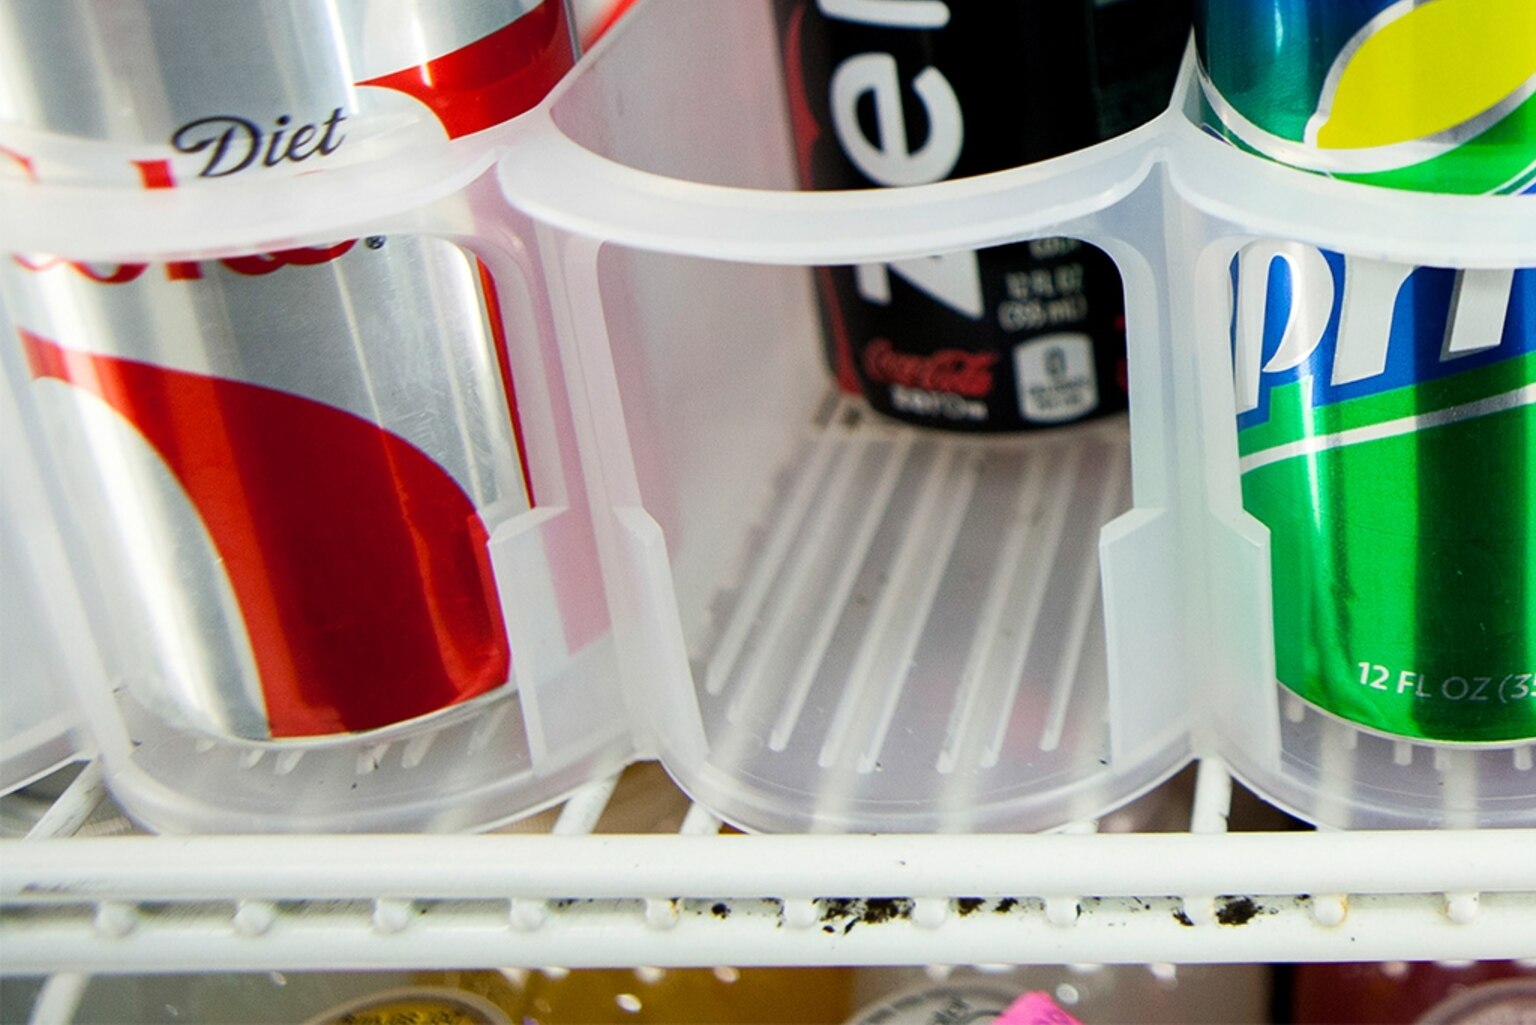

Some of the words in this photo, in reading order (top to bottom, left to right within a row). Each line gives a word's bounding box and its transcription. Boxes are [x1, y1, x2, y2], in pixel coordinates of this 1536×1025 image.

[170, 107, 348, 178] Diet
[1357, 662, 1389, 691] 12
[1396, 670, 1431, 698] FL
[1442, 675, 1492, 702] OZ
